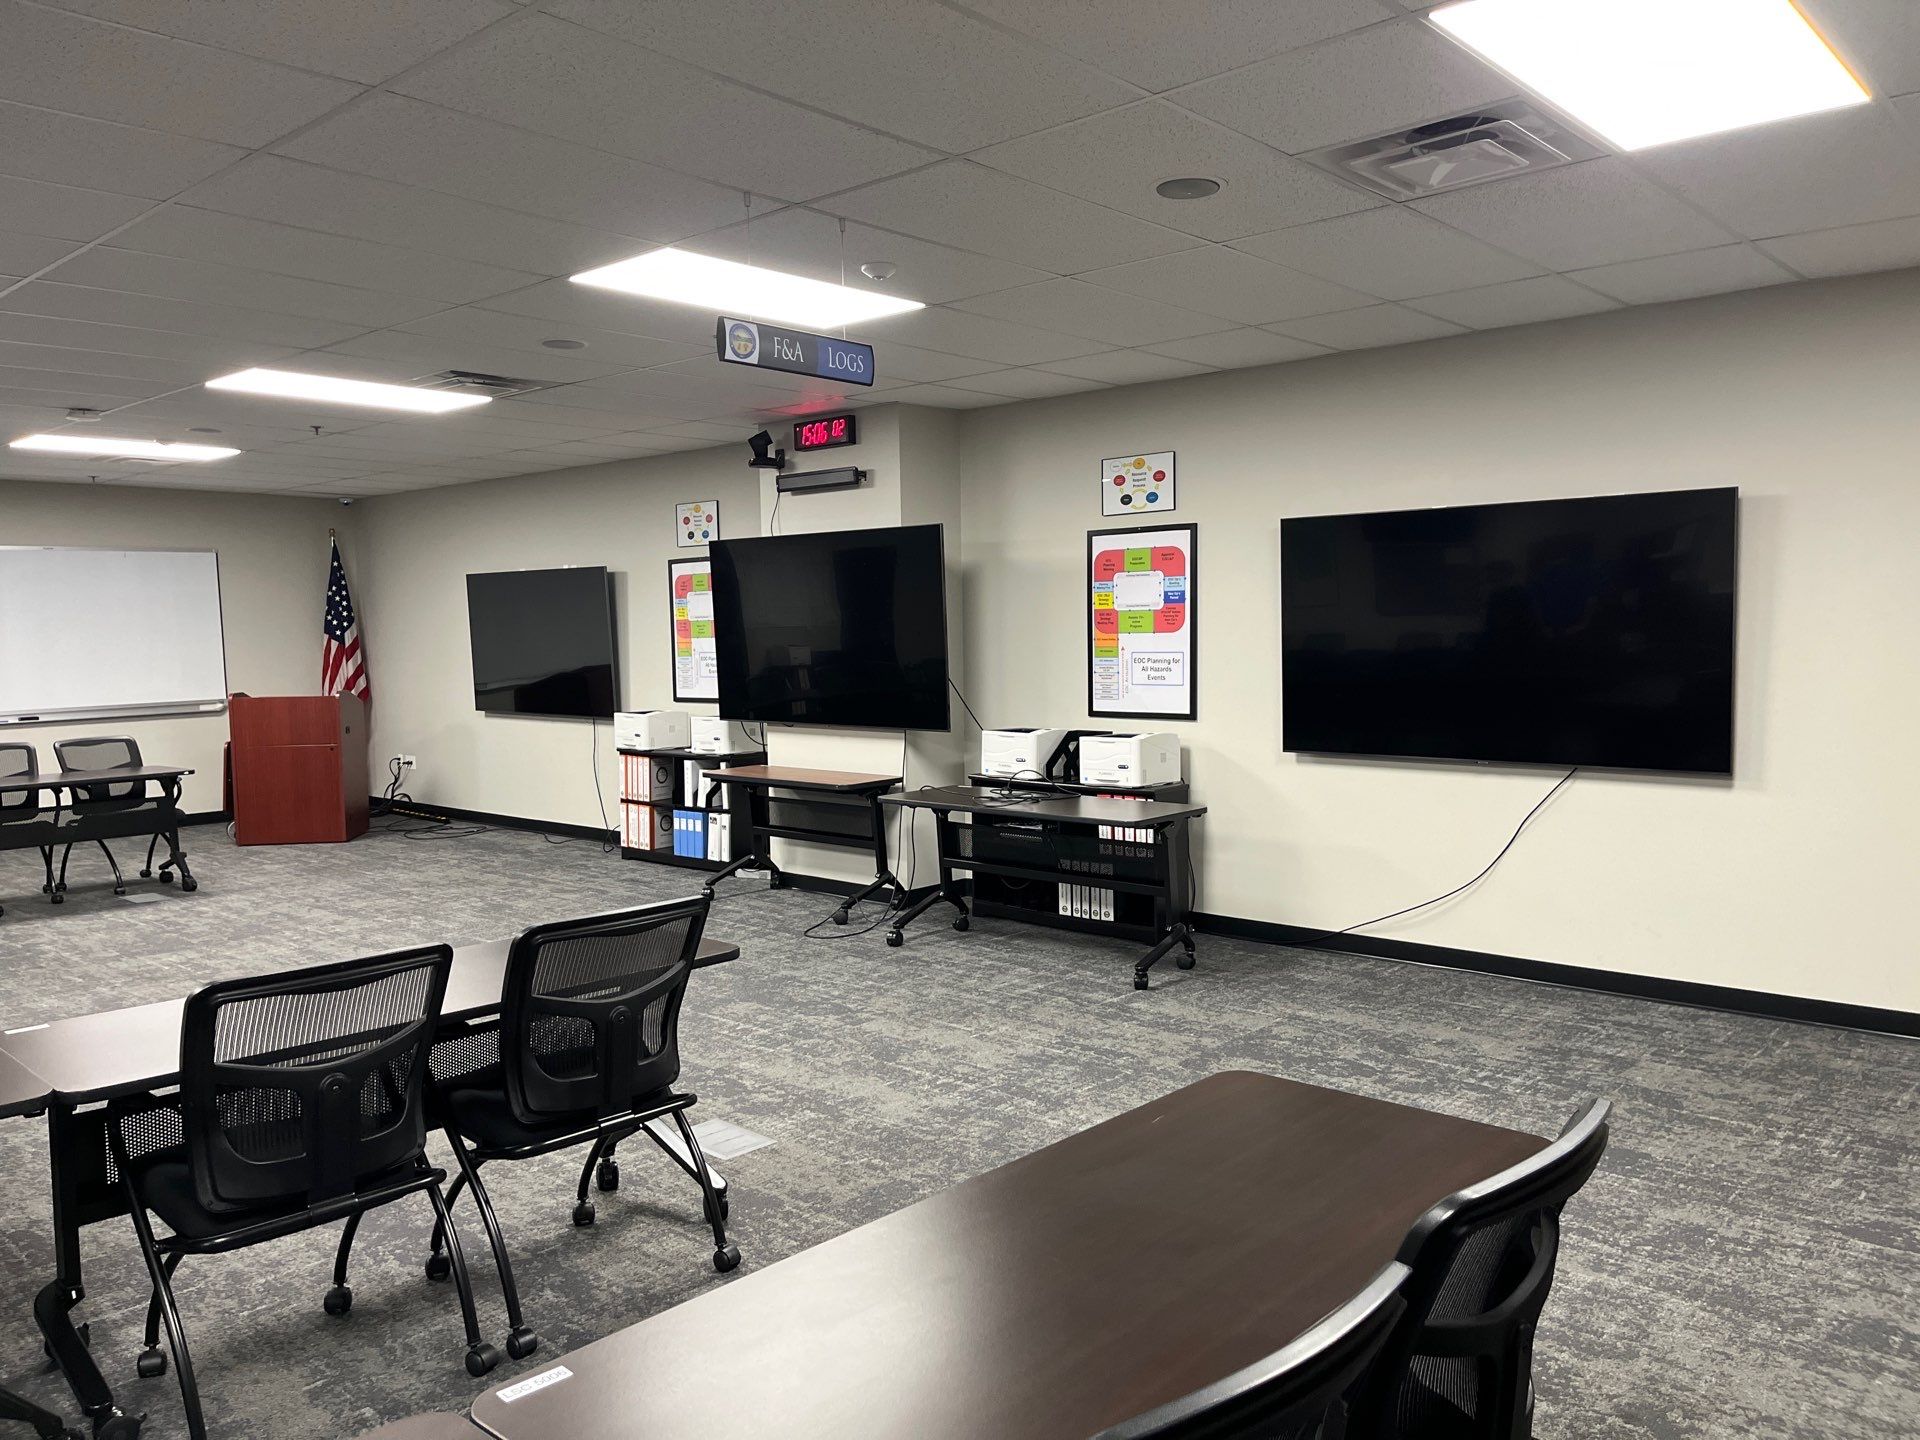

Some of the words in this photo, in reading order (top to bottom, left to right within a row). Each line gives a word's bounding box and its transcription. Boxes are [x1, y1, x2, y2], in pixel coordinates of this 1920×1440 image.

[773, 336, 804, 363] F&A
[828, 347, 864, 373] LOGS
[802, 421, 828, 446] 15:06
[1147, 657, 1171, 665] Planning
